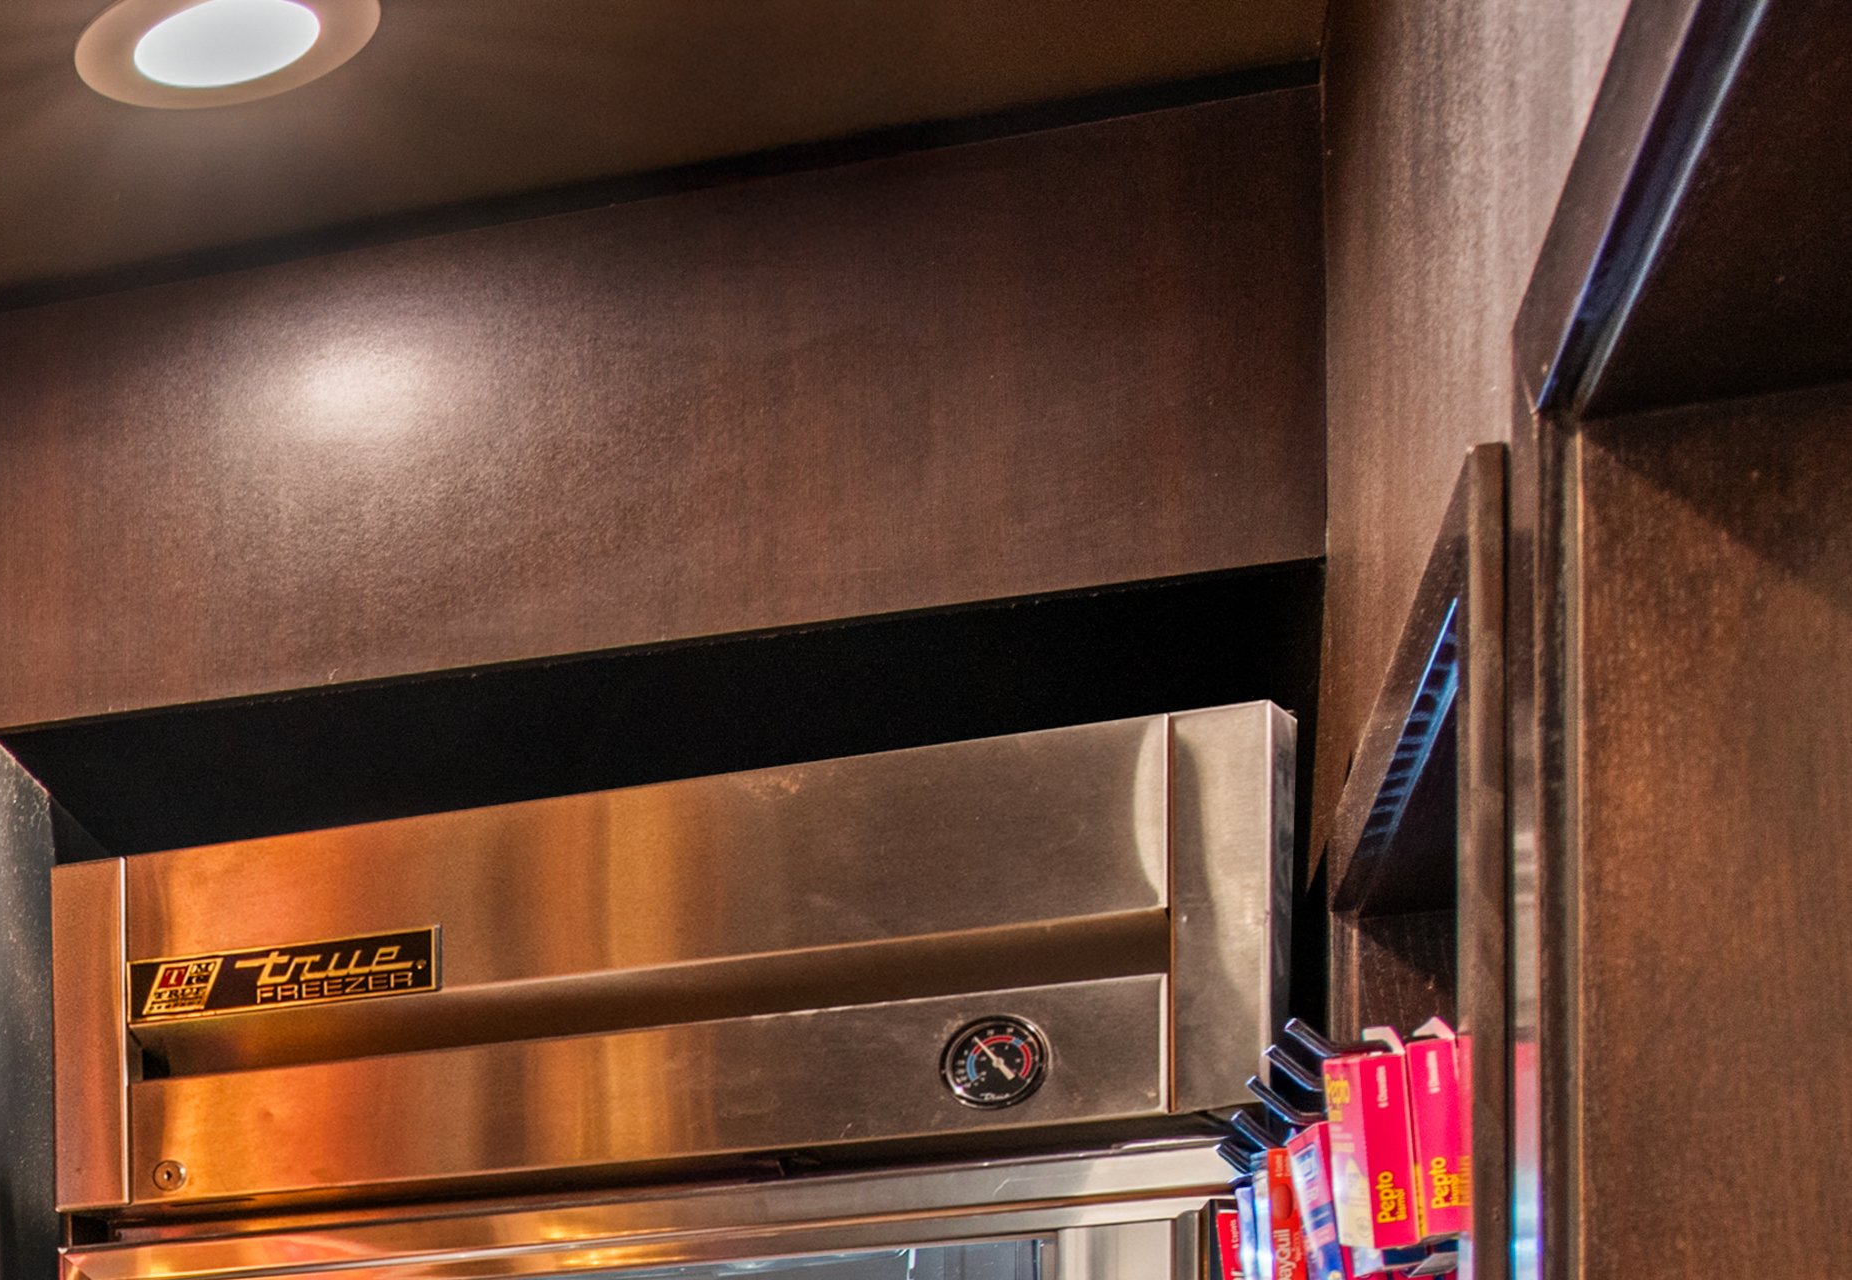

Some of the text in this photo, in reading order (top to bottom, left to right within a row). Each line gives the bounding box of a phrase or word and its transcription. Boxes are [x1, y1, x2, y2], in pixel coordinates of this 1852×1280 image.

[235, 945, 413, 987] true
[256, 971, 413, 1004] FREEZER
[1376, 1170, 1395, 1224] Pepto
[1430, 1156, 1448, 1209] Pepto
